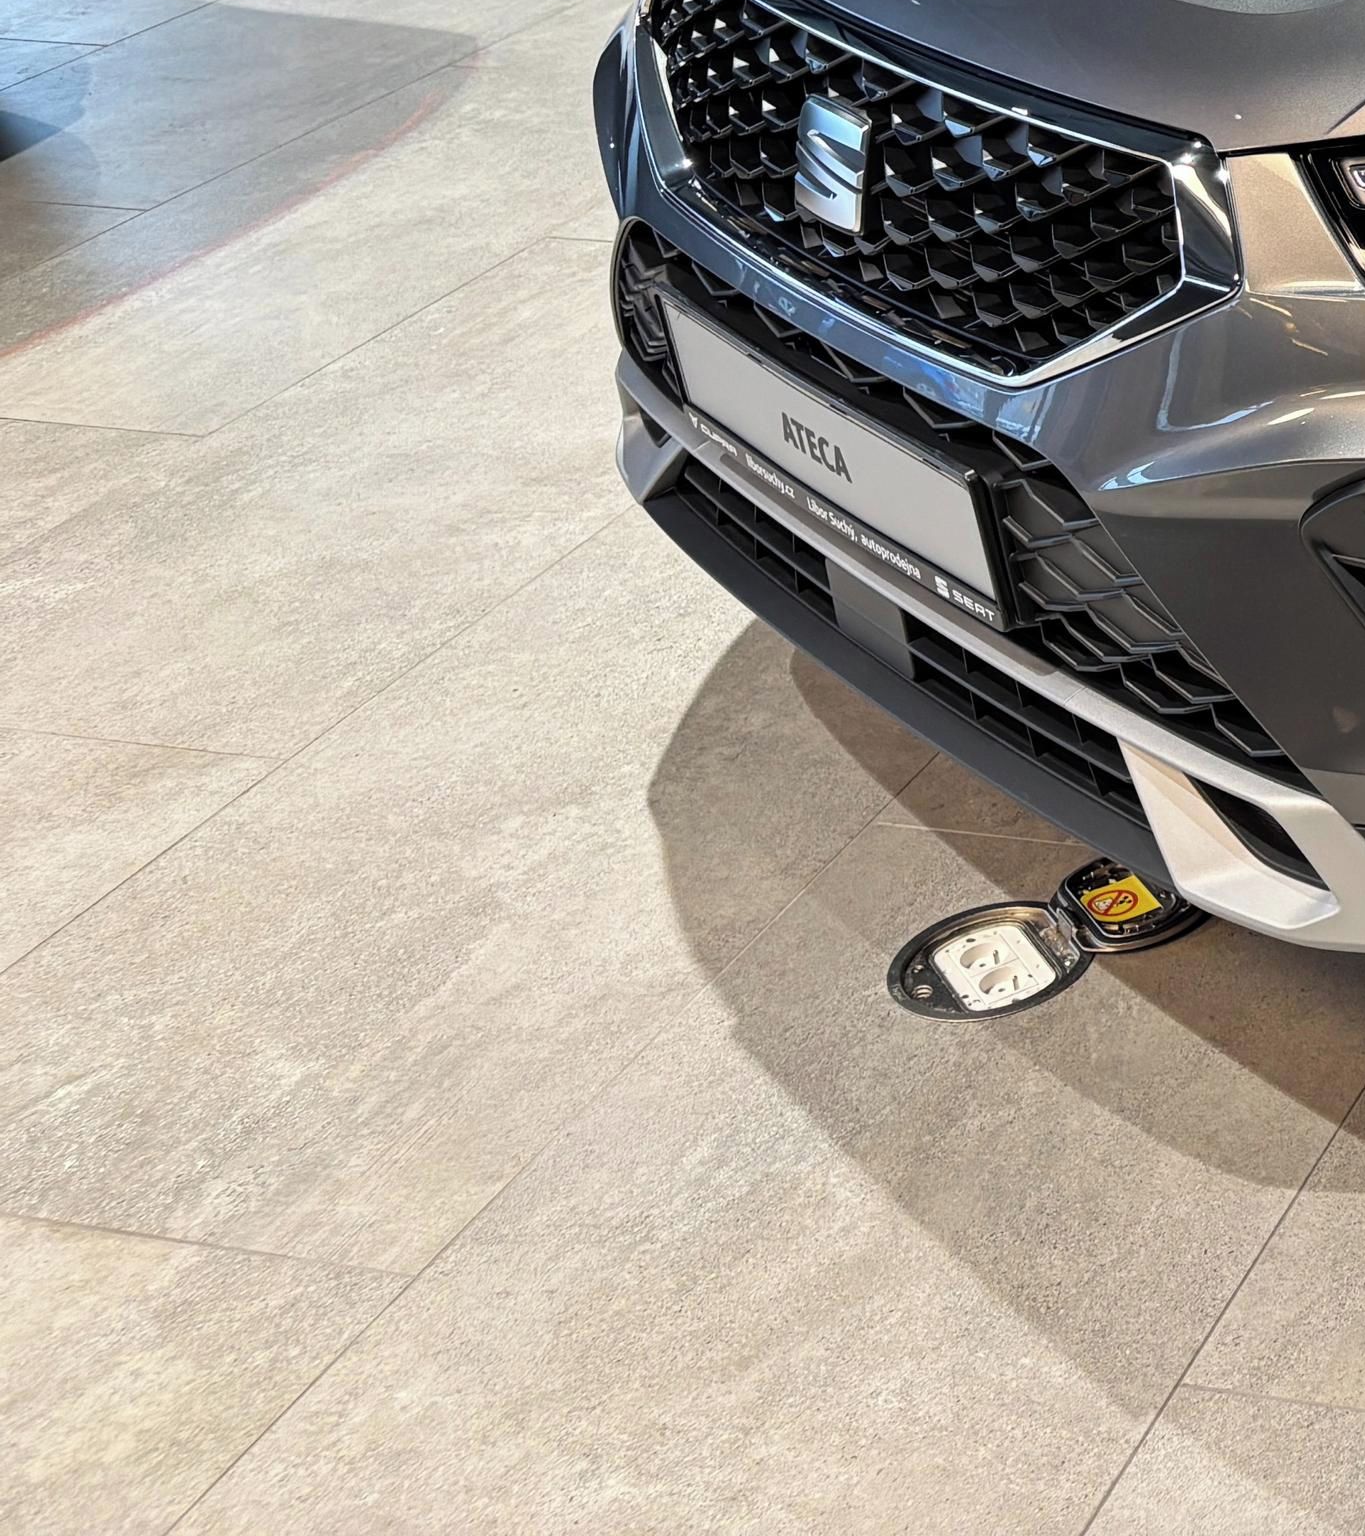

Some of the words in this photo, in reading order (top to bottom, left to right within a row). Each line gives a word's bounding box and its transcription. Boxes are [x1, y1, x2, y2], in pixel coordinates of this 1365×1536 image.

[781, 411, 853, 485] ATECA
[806, 496, 828, 520] Libor
[860, 534, 922, 580] autoprodejna
[952, 589, 996, 622] SEAT
